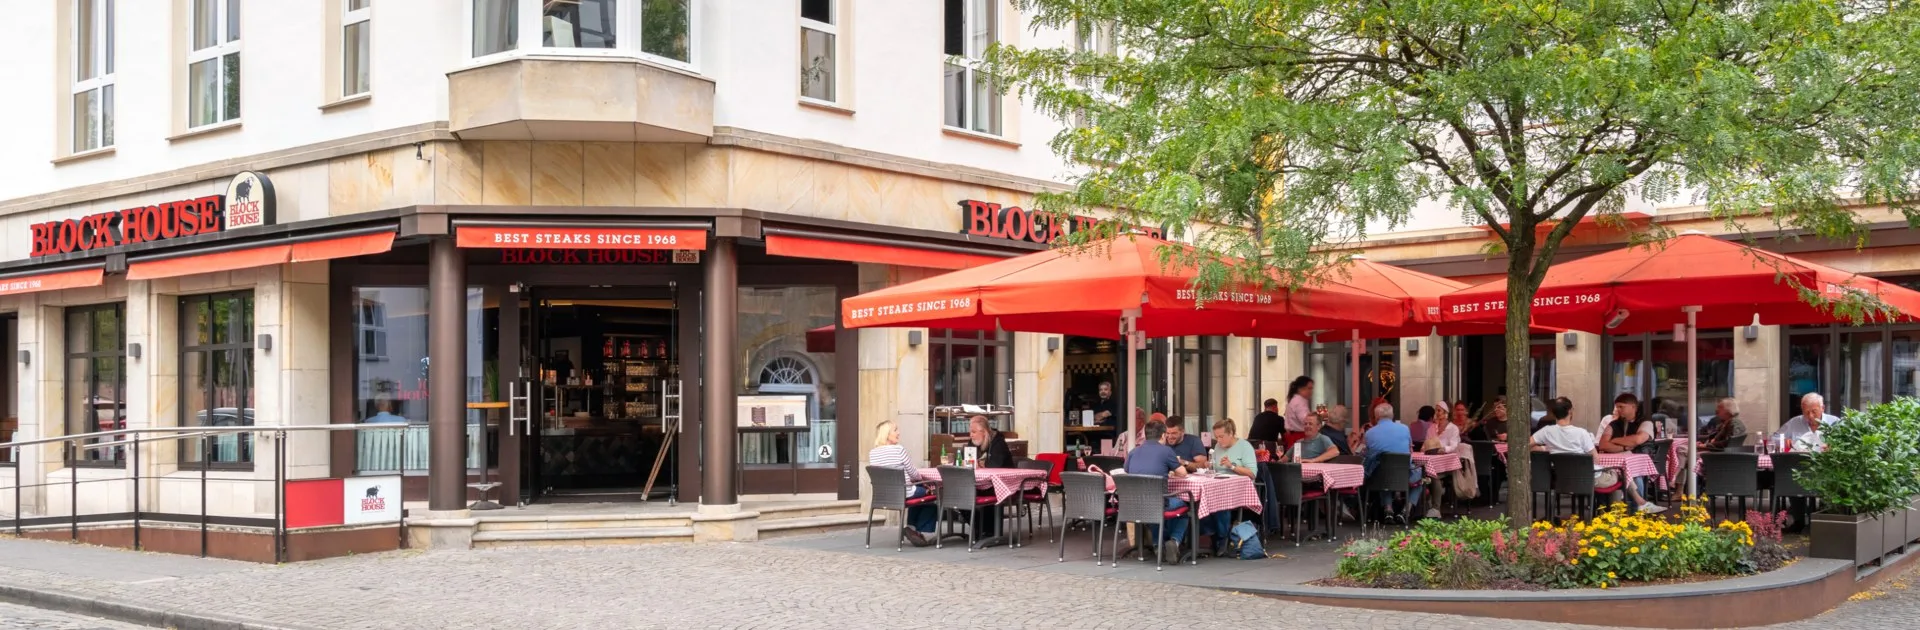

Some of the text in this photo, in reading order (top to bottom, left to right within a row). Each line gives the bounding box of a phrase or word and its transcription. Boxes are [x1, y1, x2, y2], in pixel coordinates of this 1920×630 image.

[229, 200, 260, 215] BLOCK
[30, 194, 220, 257] BLOCK HOUSE
[229, 212, 260, 227] HOUSE
[494, 233, 677, 245] BEST STEAKS SINCE 1968
[501, 249, 668, 264] BLOCK HOUSE
[1176, 289, 1195, 300] BEST
[1231, 292, 1254, 303] SINCE
[1256, 294, 1272, 304] 1968
[1453, 303, 1479, 314] BEST
[1533, 295, 1570, 307] SINCE
[1575, 293, 1600, 304] 1968
[851, 297, 970, 319] BEST STEAKS SINCE 1968
[820, 446, 830, 455] A
[361, 503, 385, 511] HOUSE
